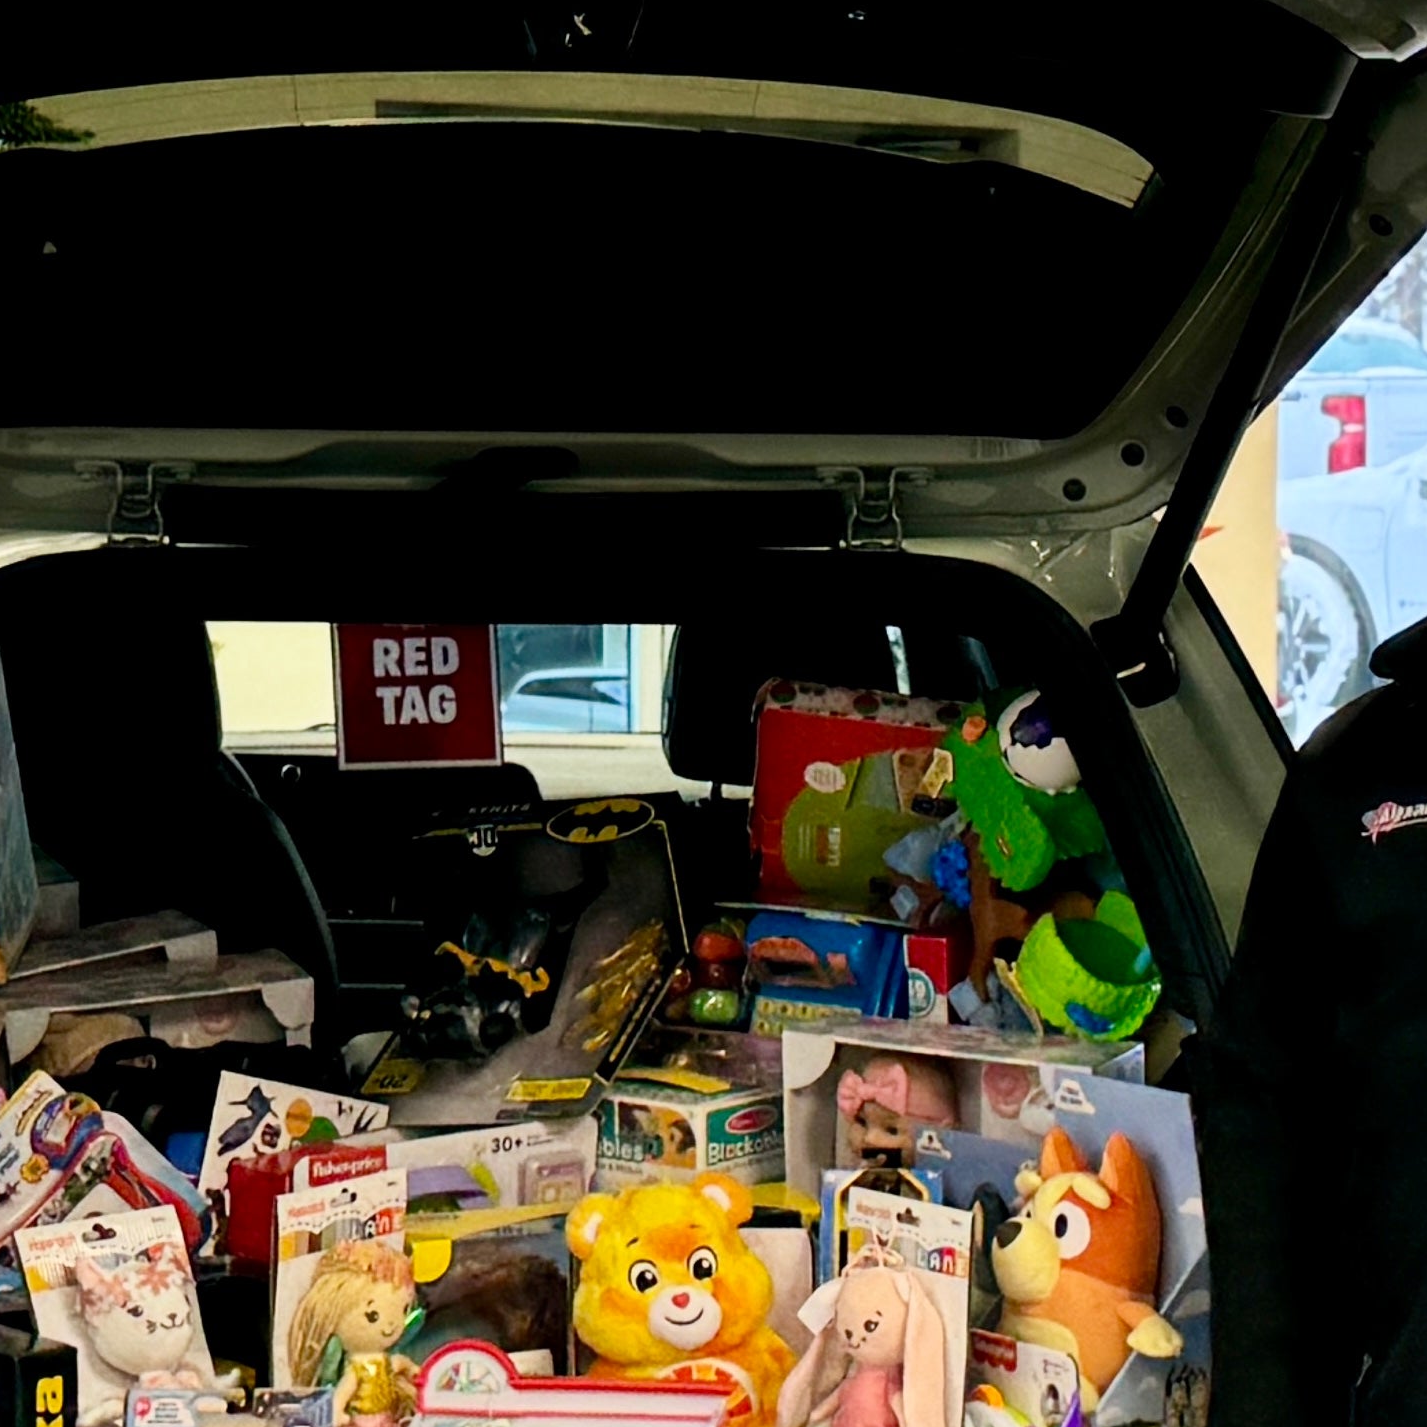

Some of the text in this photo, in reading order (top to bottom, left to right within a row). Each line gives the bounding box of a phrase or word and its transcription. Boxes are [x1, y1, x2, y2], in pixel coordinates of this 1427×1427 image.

[373, 636, 460, 678] RED
[375, 684, 458, 725] TAG
[490, 1136, 524, 1154] 30+
[598, 1137, 644, 1161] bles
